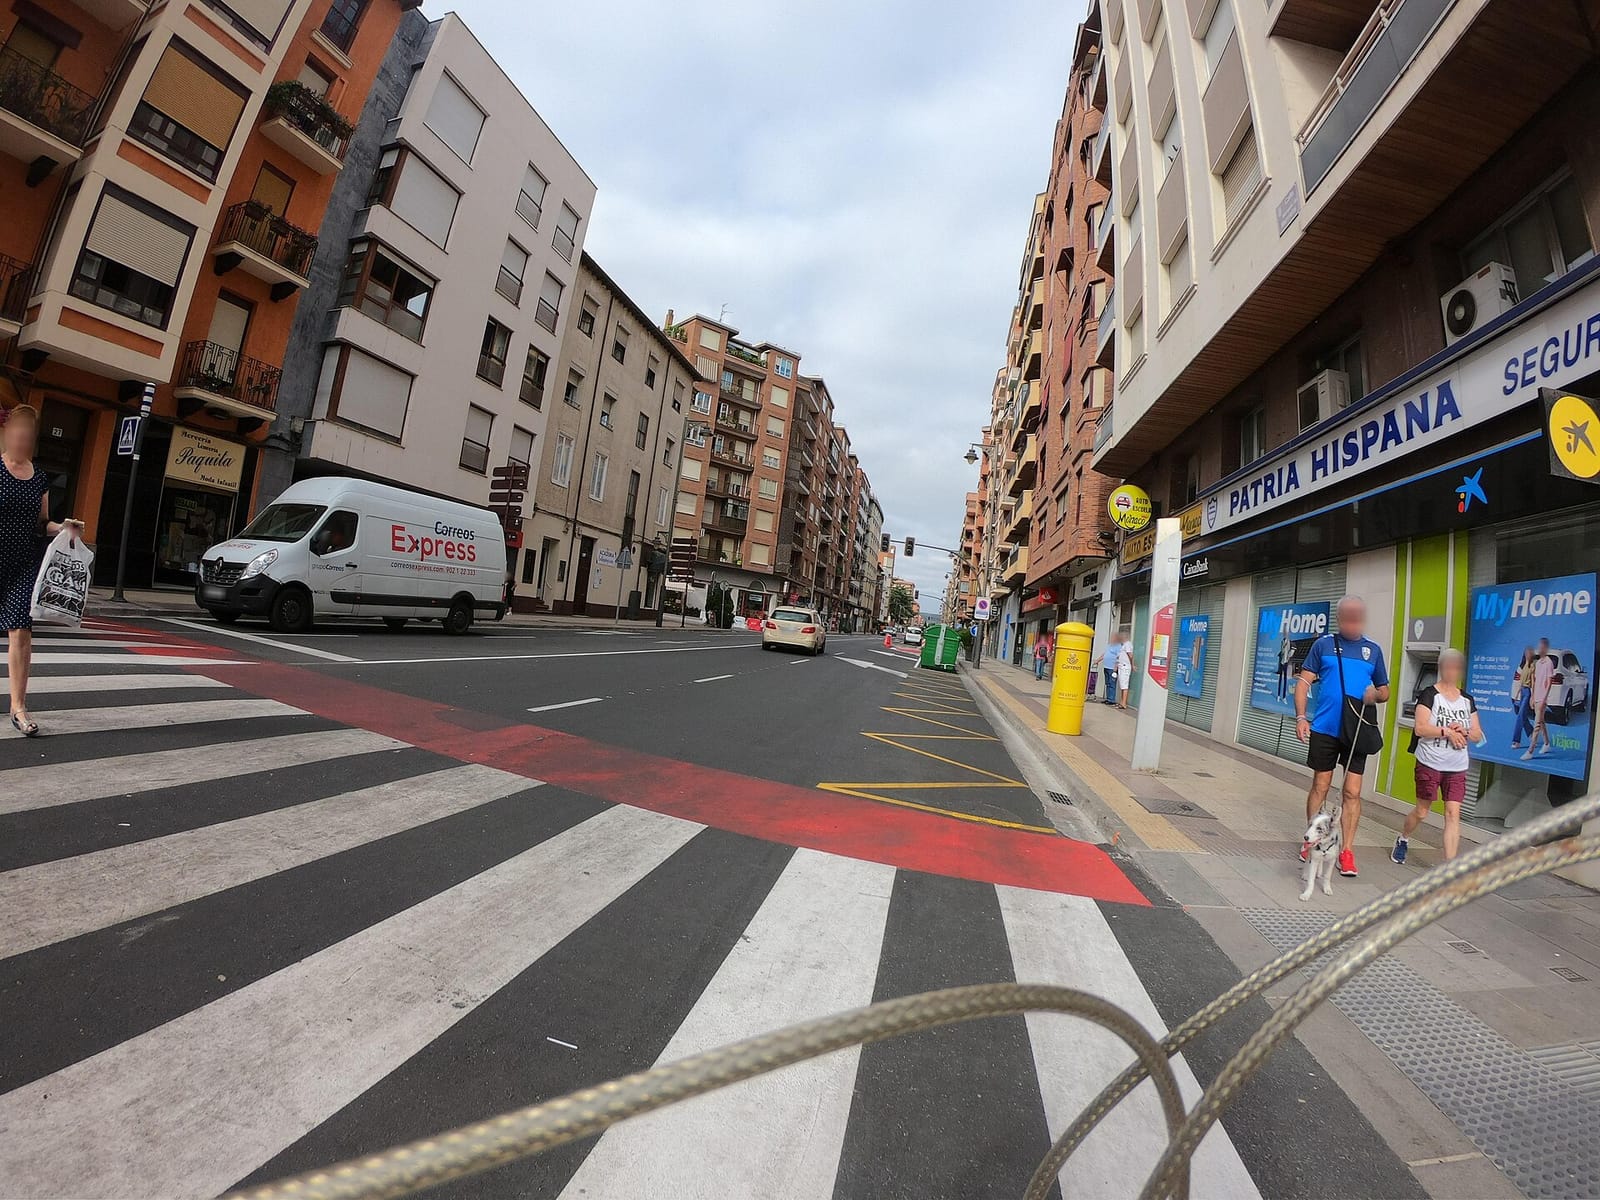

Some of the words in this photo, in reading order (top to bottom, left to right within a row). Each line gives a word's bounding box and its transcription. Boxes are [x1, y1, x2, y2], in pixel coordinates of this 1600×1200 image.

[174, 446, 235, 473] Paquita
[1229, 460, 1300, 517] PATRIA
[1311, 379, 1463, 482] HISPANA
[391, 524, 476, 562] Express
[434, 521, 475, 541] Correos
[1183, 557, 1209, 576] CaixaBank
[1475, 589, 1591, 627] MyHome
[1260, 608, 1327, 640] MyHome
[1061, 663, 1082, 671] Correos
[1437, 705, 1453, 718] ALL
